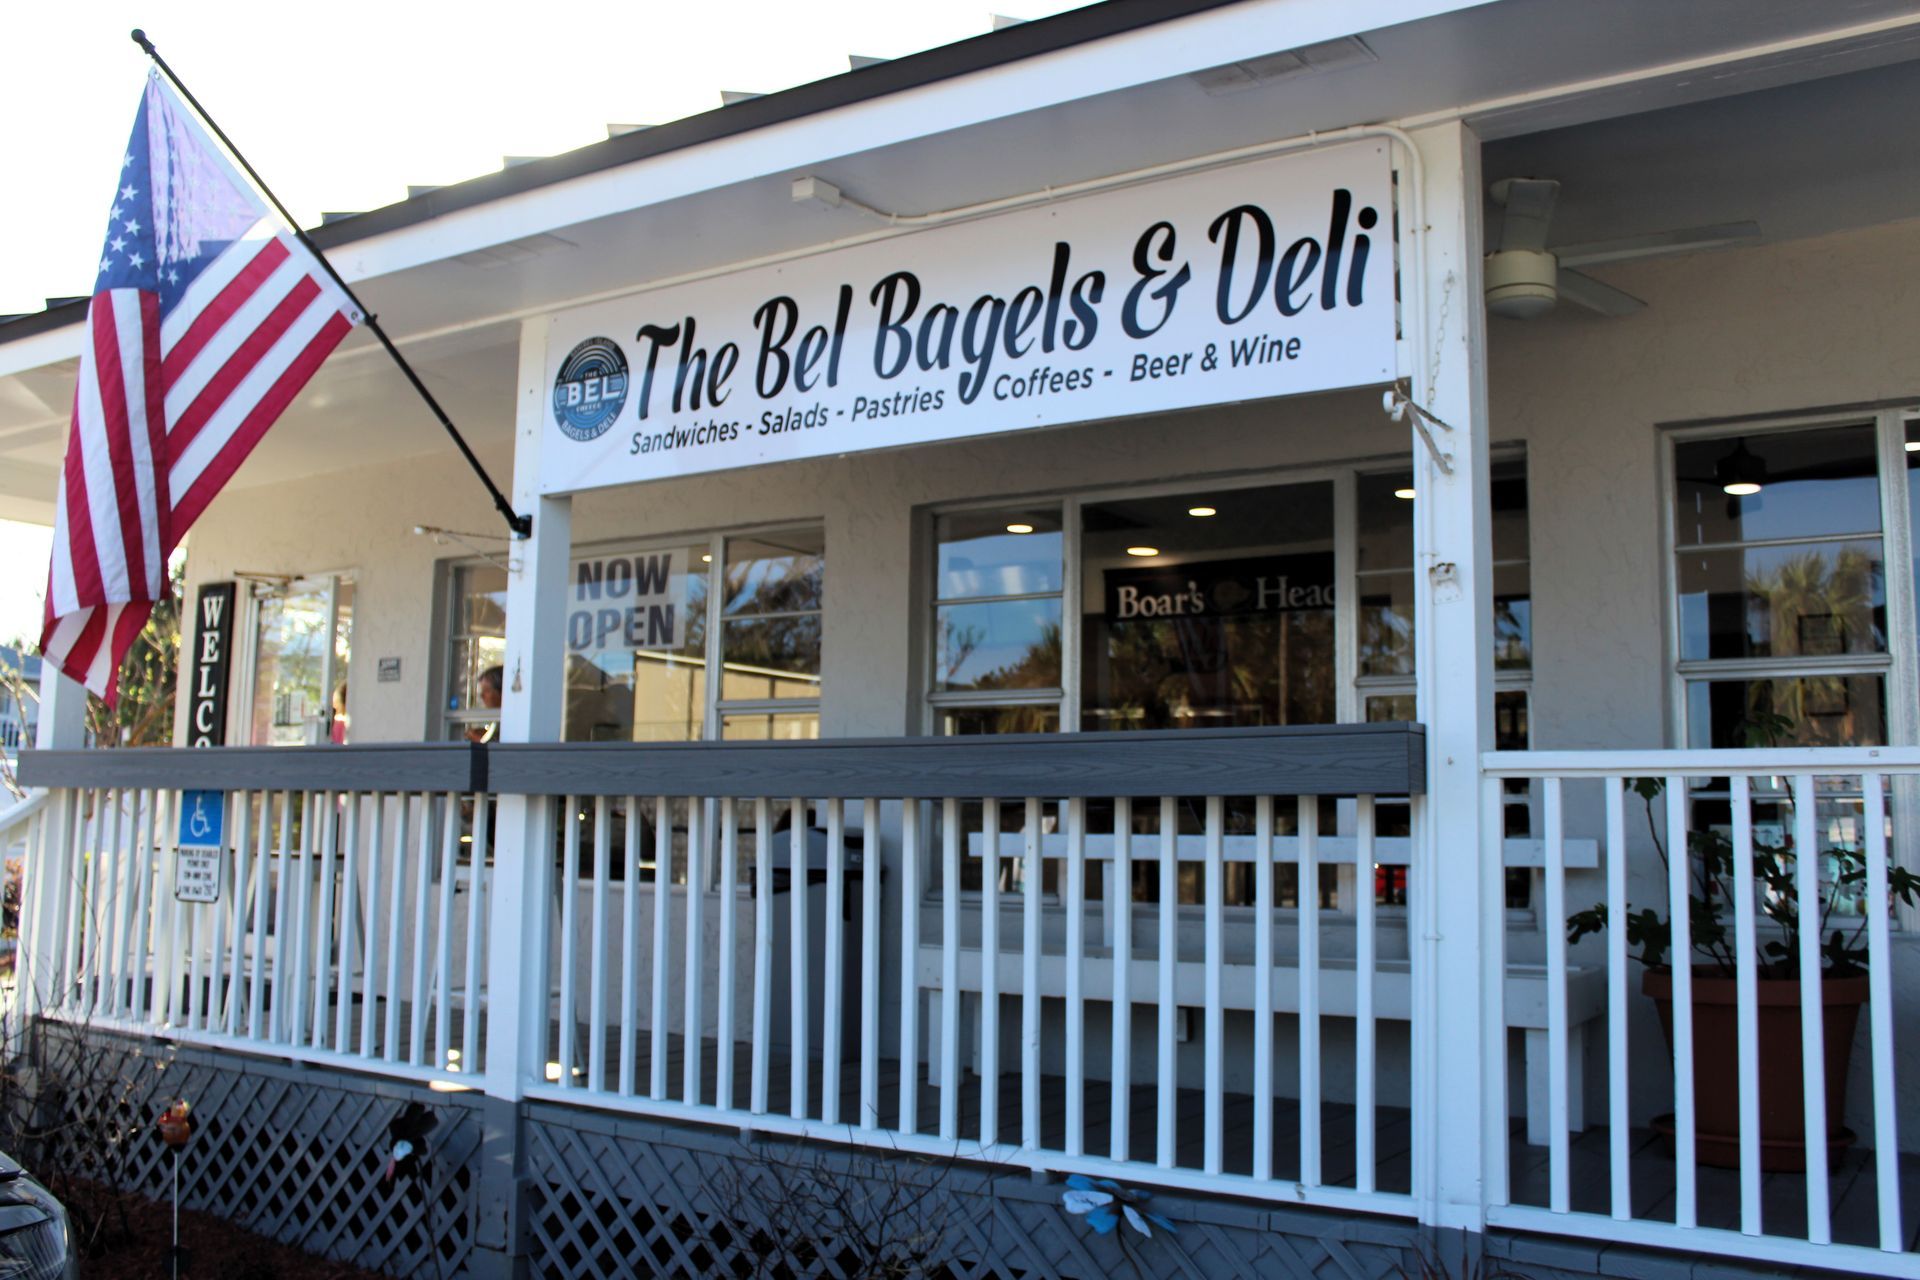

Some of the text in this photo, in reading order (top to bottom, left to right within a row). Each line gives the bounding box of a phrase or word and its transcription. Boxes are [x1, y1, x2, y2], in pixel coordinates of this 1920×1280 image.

[635, 188, 1378, 421] The Bel Bagels & Deli
[565, 376, 621, 407] BEL
[993, 366, 1094, 401] Coffees
[1129, 350, 1194, 382] Beer
[1201, 343, 1218, 372] &
[1230, 336, 1301, 369] Wine
[561, 411, 617, 441] BAGELS & DELI
[630, 419, 739, 455] Sandwiches
[758, 401, 828, 436] Salads
[851, 385, 945, 422] Pastries
[577, 554, 672, 601] NOW
[568, 603, 675, 651] OPEN
